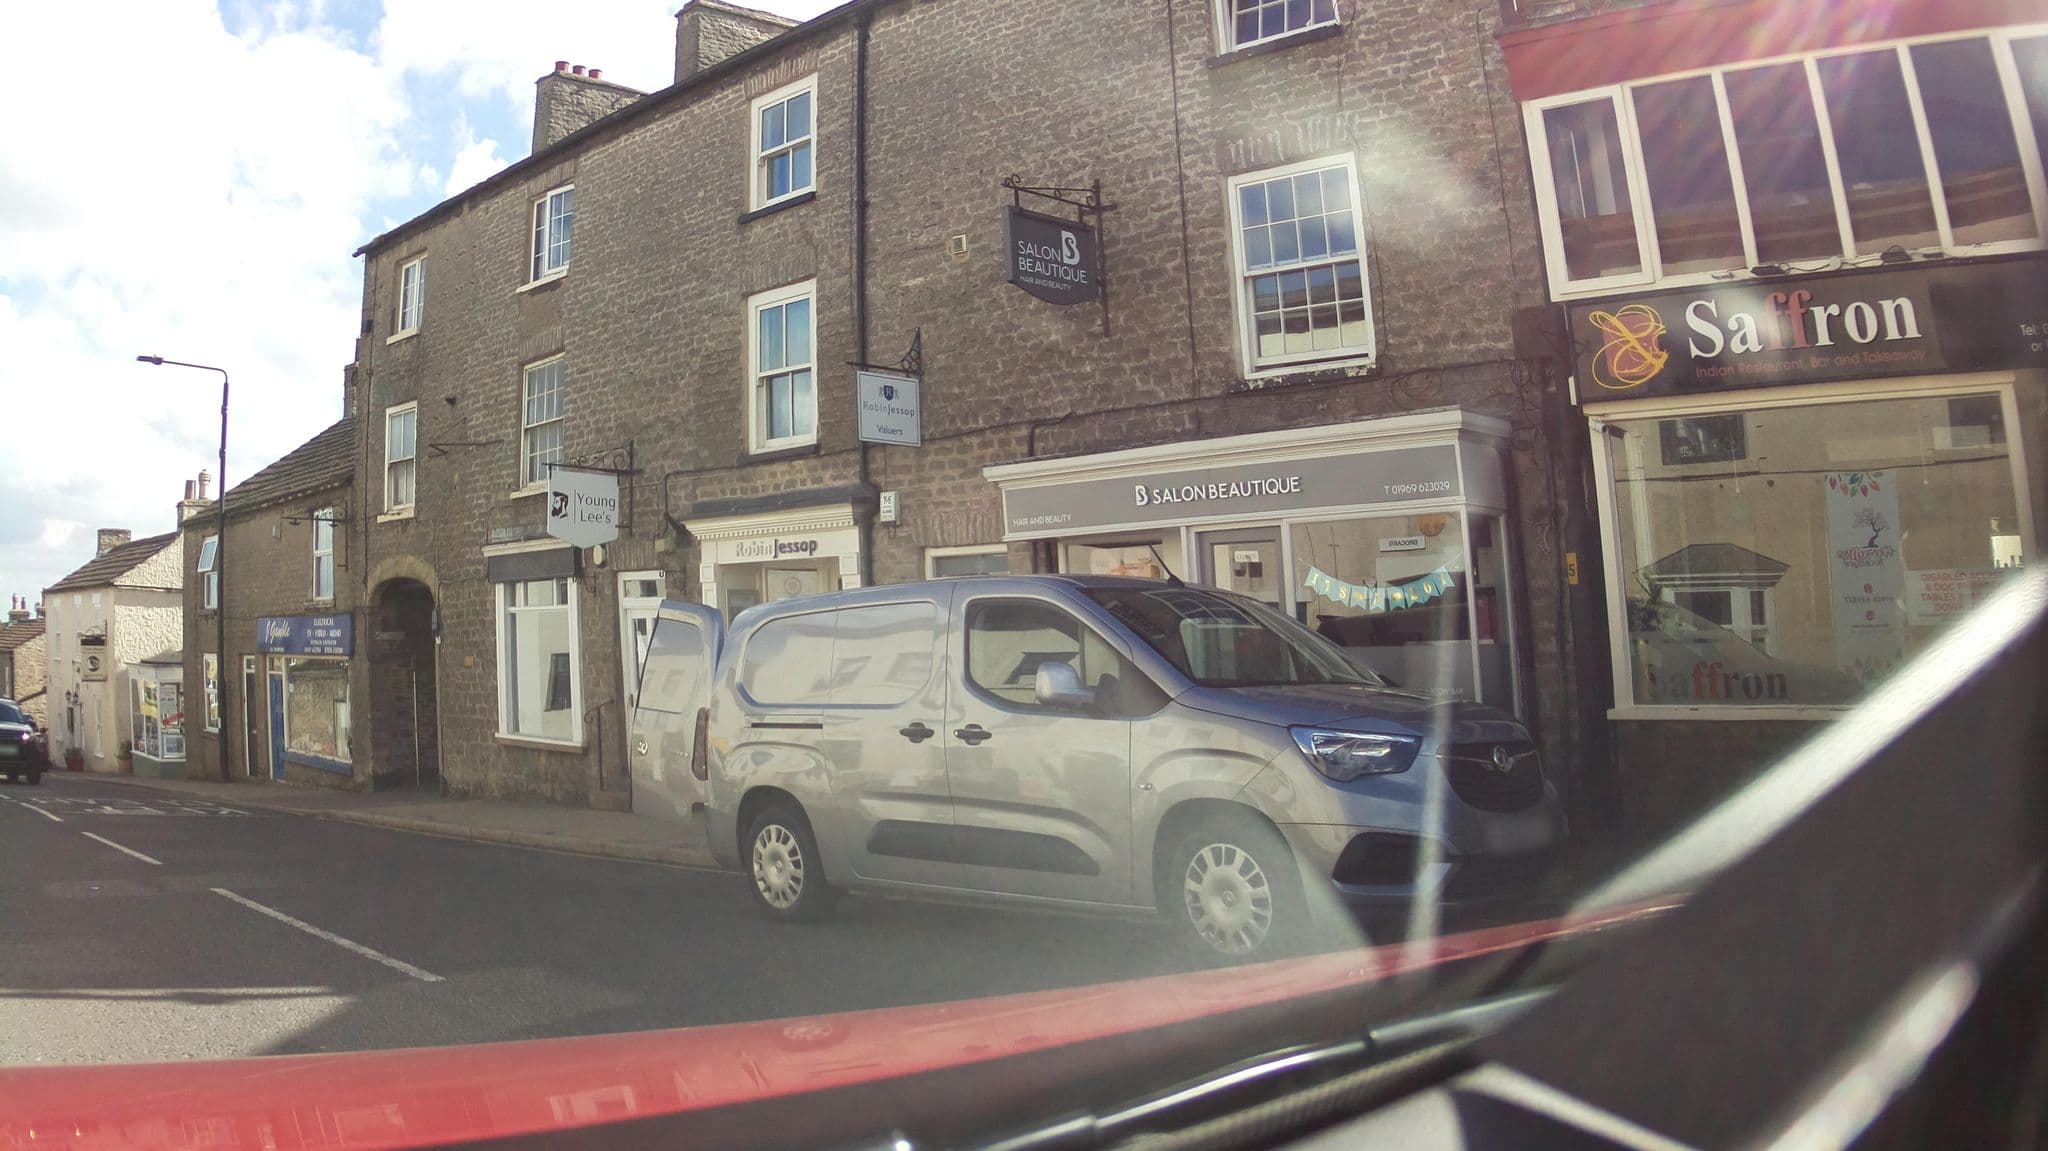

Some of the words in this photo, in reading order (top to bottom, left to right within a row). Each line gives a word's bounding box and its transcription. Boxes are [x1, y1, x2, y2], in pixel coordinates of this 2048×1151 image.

[1018, 240, 1061, 262] SALON
[1018, 257, 1088, 284] BEAUTIQUE
[1048, 281, 1072, 291] BEAUTY
[1685, 289, 1923, 359] Saffron
[1696, 365, 1735, 379] Indian
[1811, 356, 1833, 369] Bar
[1835, 352, 1860, 367] and
[1863, 349, 1927, 365] Takeaway
[876, 424, 904, 436] Valuers
[1152, 484, 1206, 504] SALON
[1208, 476, 1301, 499] BEAUTIQUE
[1391, 483, 1418, 495] 01969
[1418, 480, 1450, 493] 623029
[577, 492, 616, 511] Young
[580, 510, 612, 524] Lee's
[1013, 518, 1029, 527] HAIR
[1029, 516, 1045, 525] AND
[1045, 513, 1072, 524] BEAUTY
[773, 538, 818, 559] Jessop
